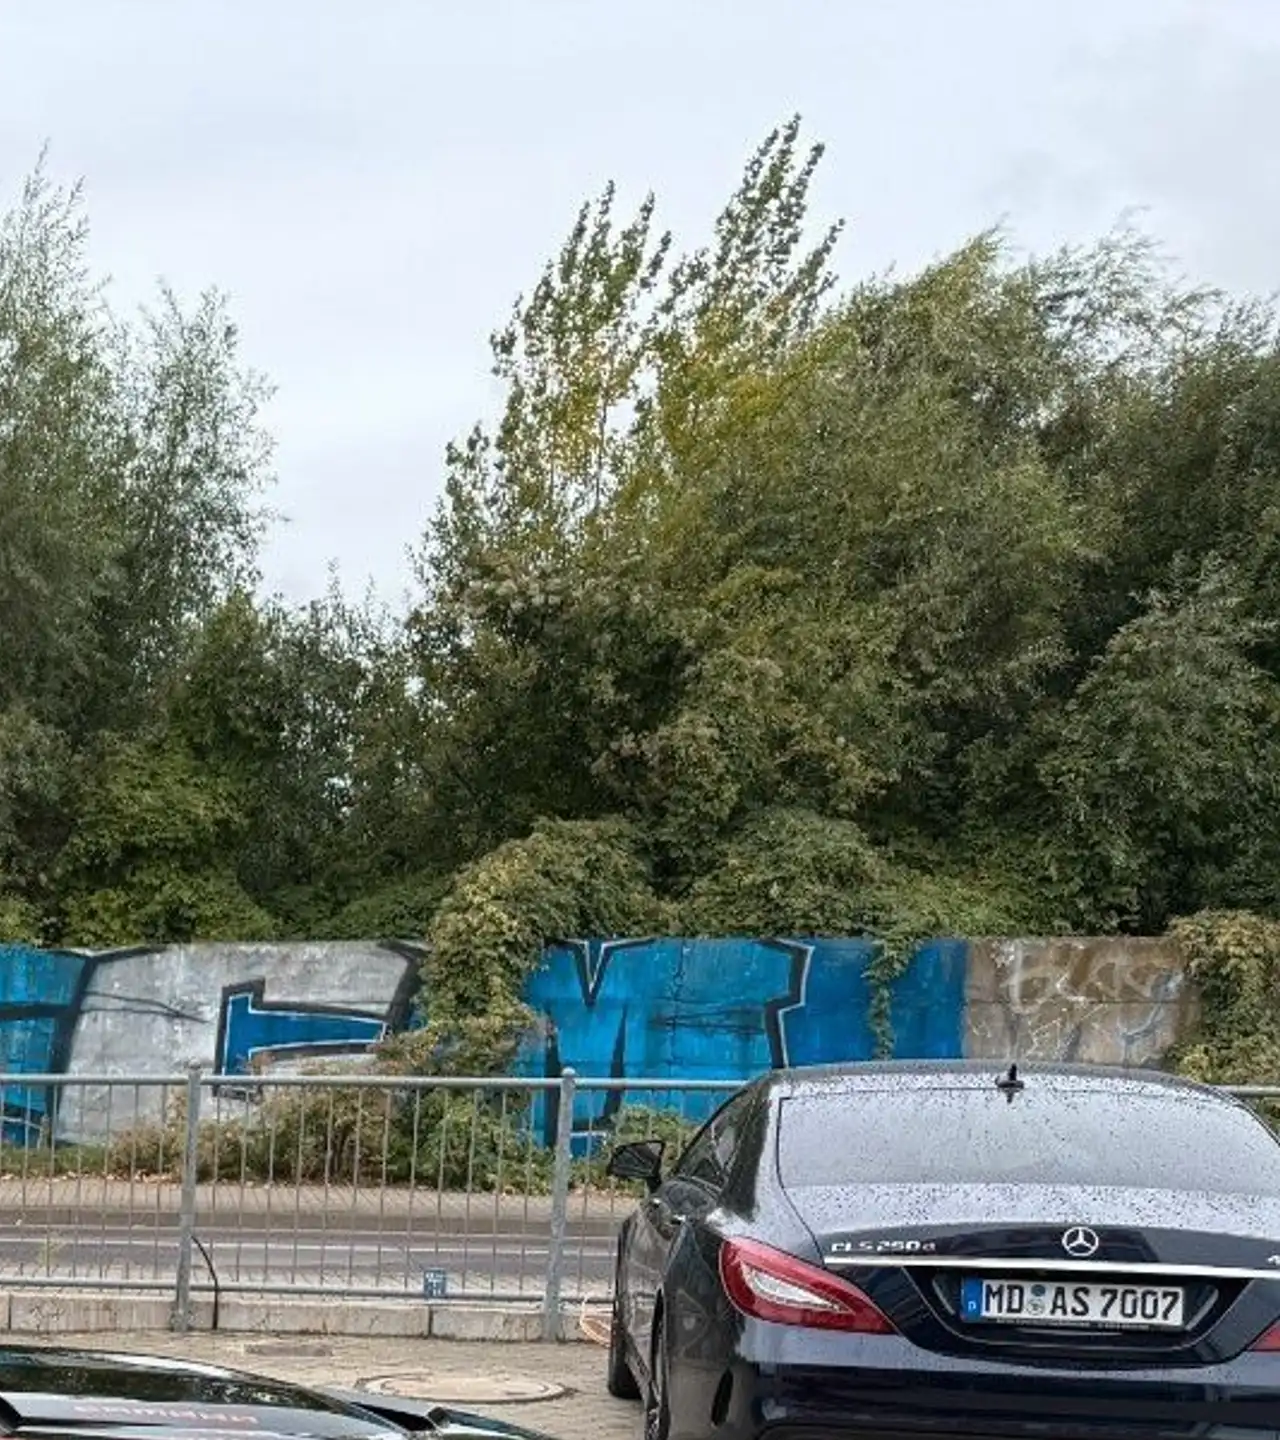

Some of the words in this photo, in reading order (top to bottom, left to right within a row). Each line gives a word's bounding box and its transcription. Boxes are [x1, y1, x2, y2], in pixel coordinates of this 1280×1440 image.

[984, 1283, 1025, 1314] MD
[1049, 1286, 1091, 1316] AS
[1100, 1288, 1180, 1321] 7007
